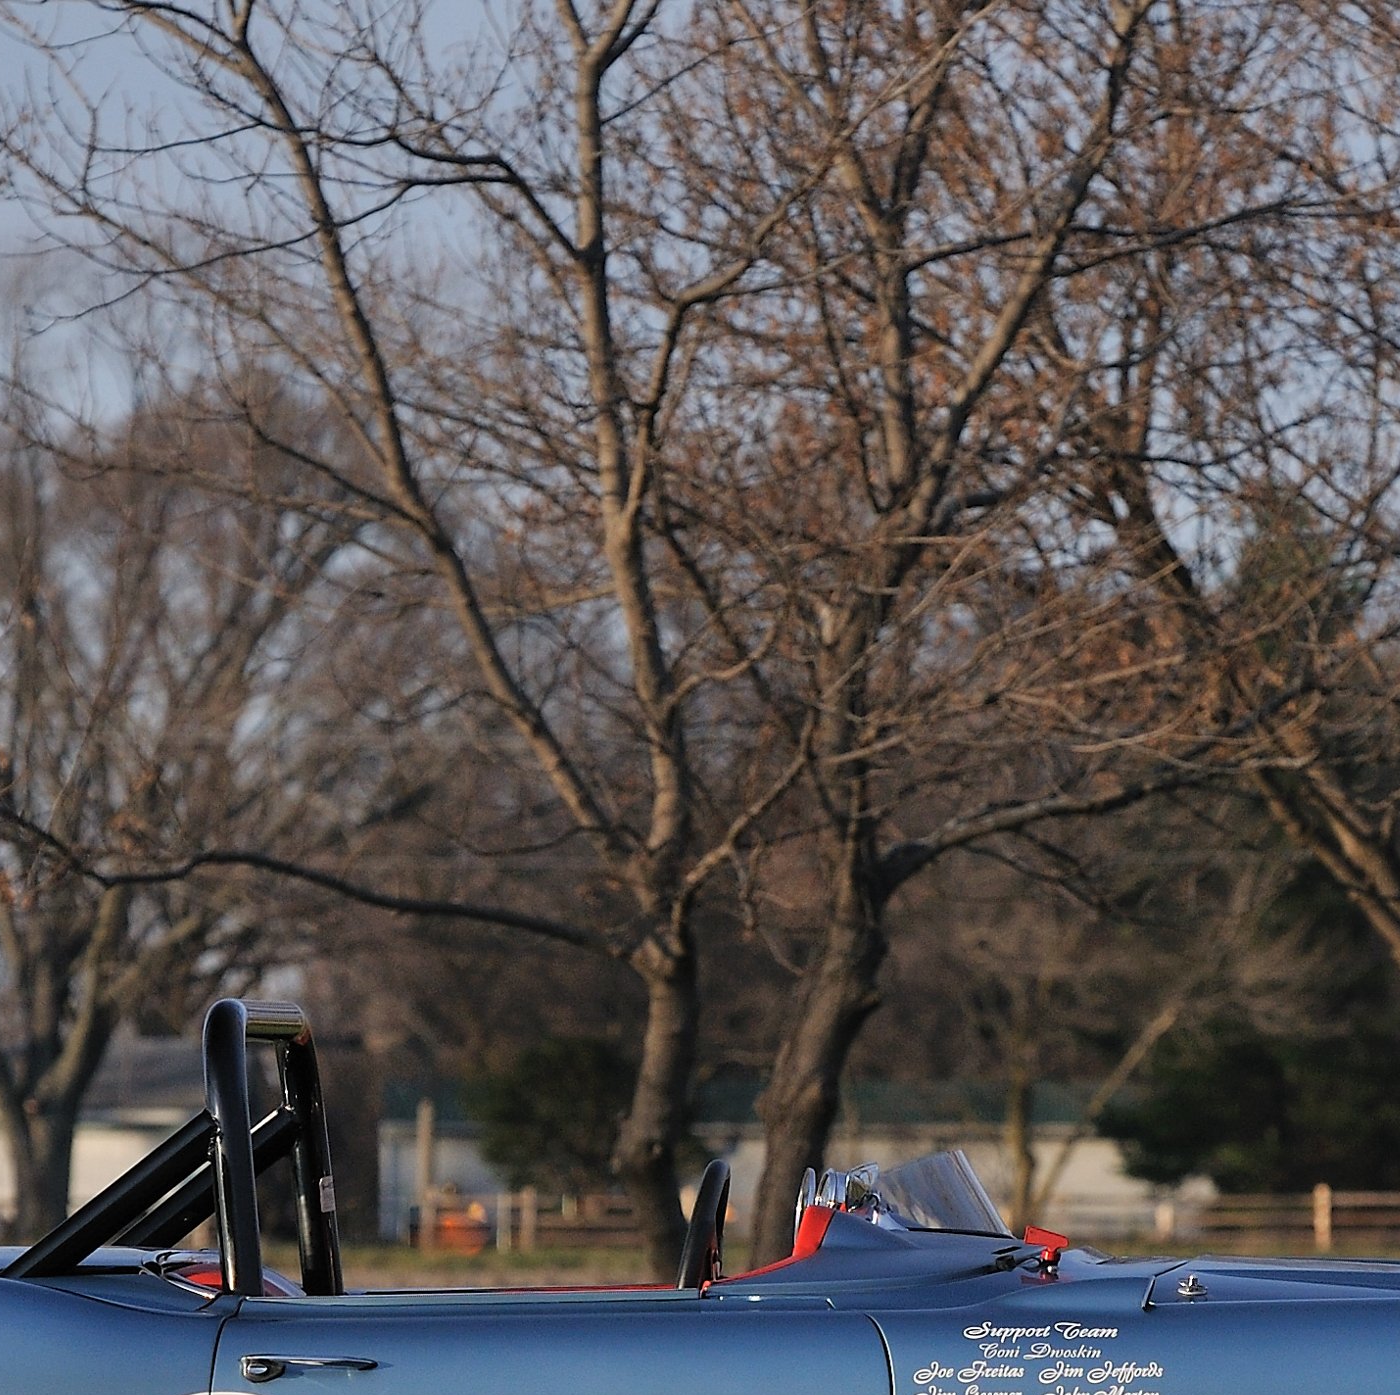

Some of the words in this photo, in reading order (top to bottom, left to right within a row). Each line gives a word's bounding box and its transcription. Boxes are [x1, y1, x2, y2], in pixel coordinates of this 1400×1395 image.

[963, 1321, 1050, 1343] Support
[1054, 1322, 1118, 1339] Team
[1023, 1343, 1102, 1360] Dwoskin
[913, 1361, 954, 1384] Joe
[957, 1361, 1025, 1383] Freitas
[1038, 1361, 1084, 1384] Jim
[1087, 1361, 1164, 1384] Jeffords
